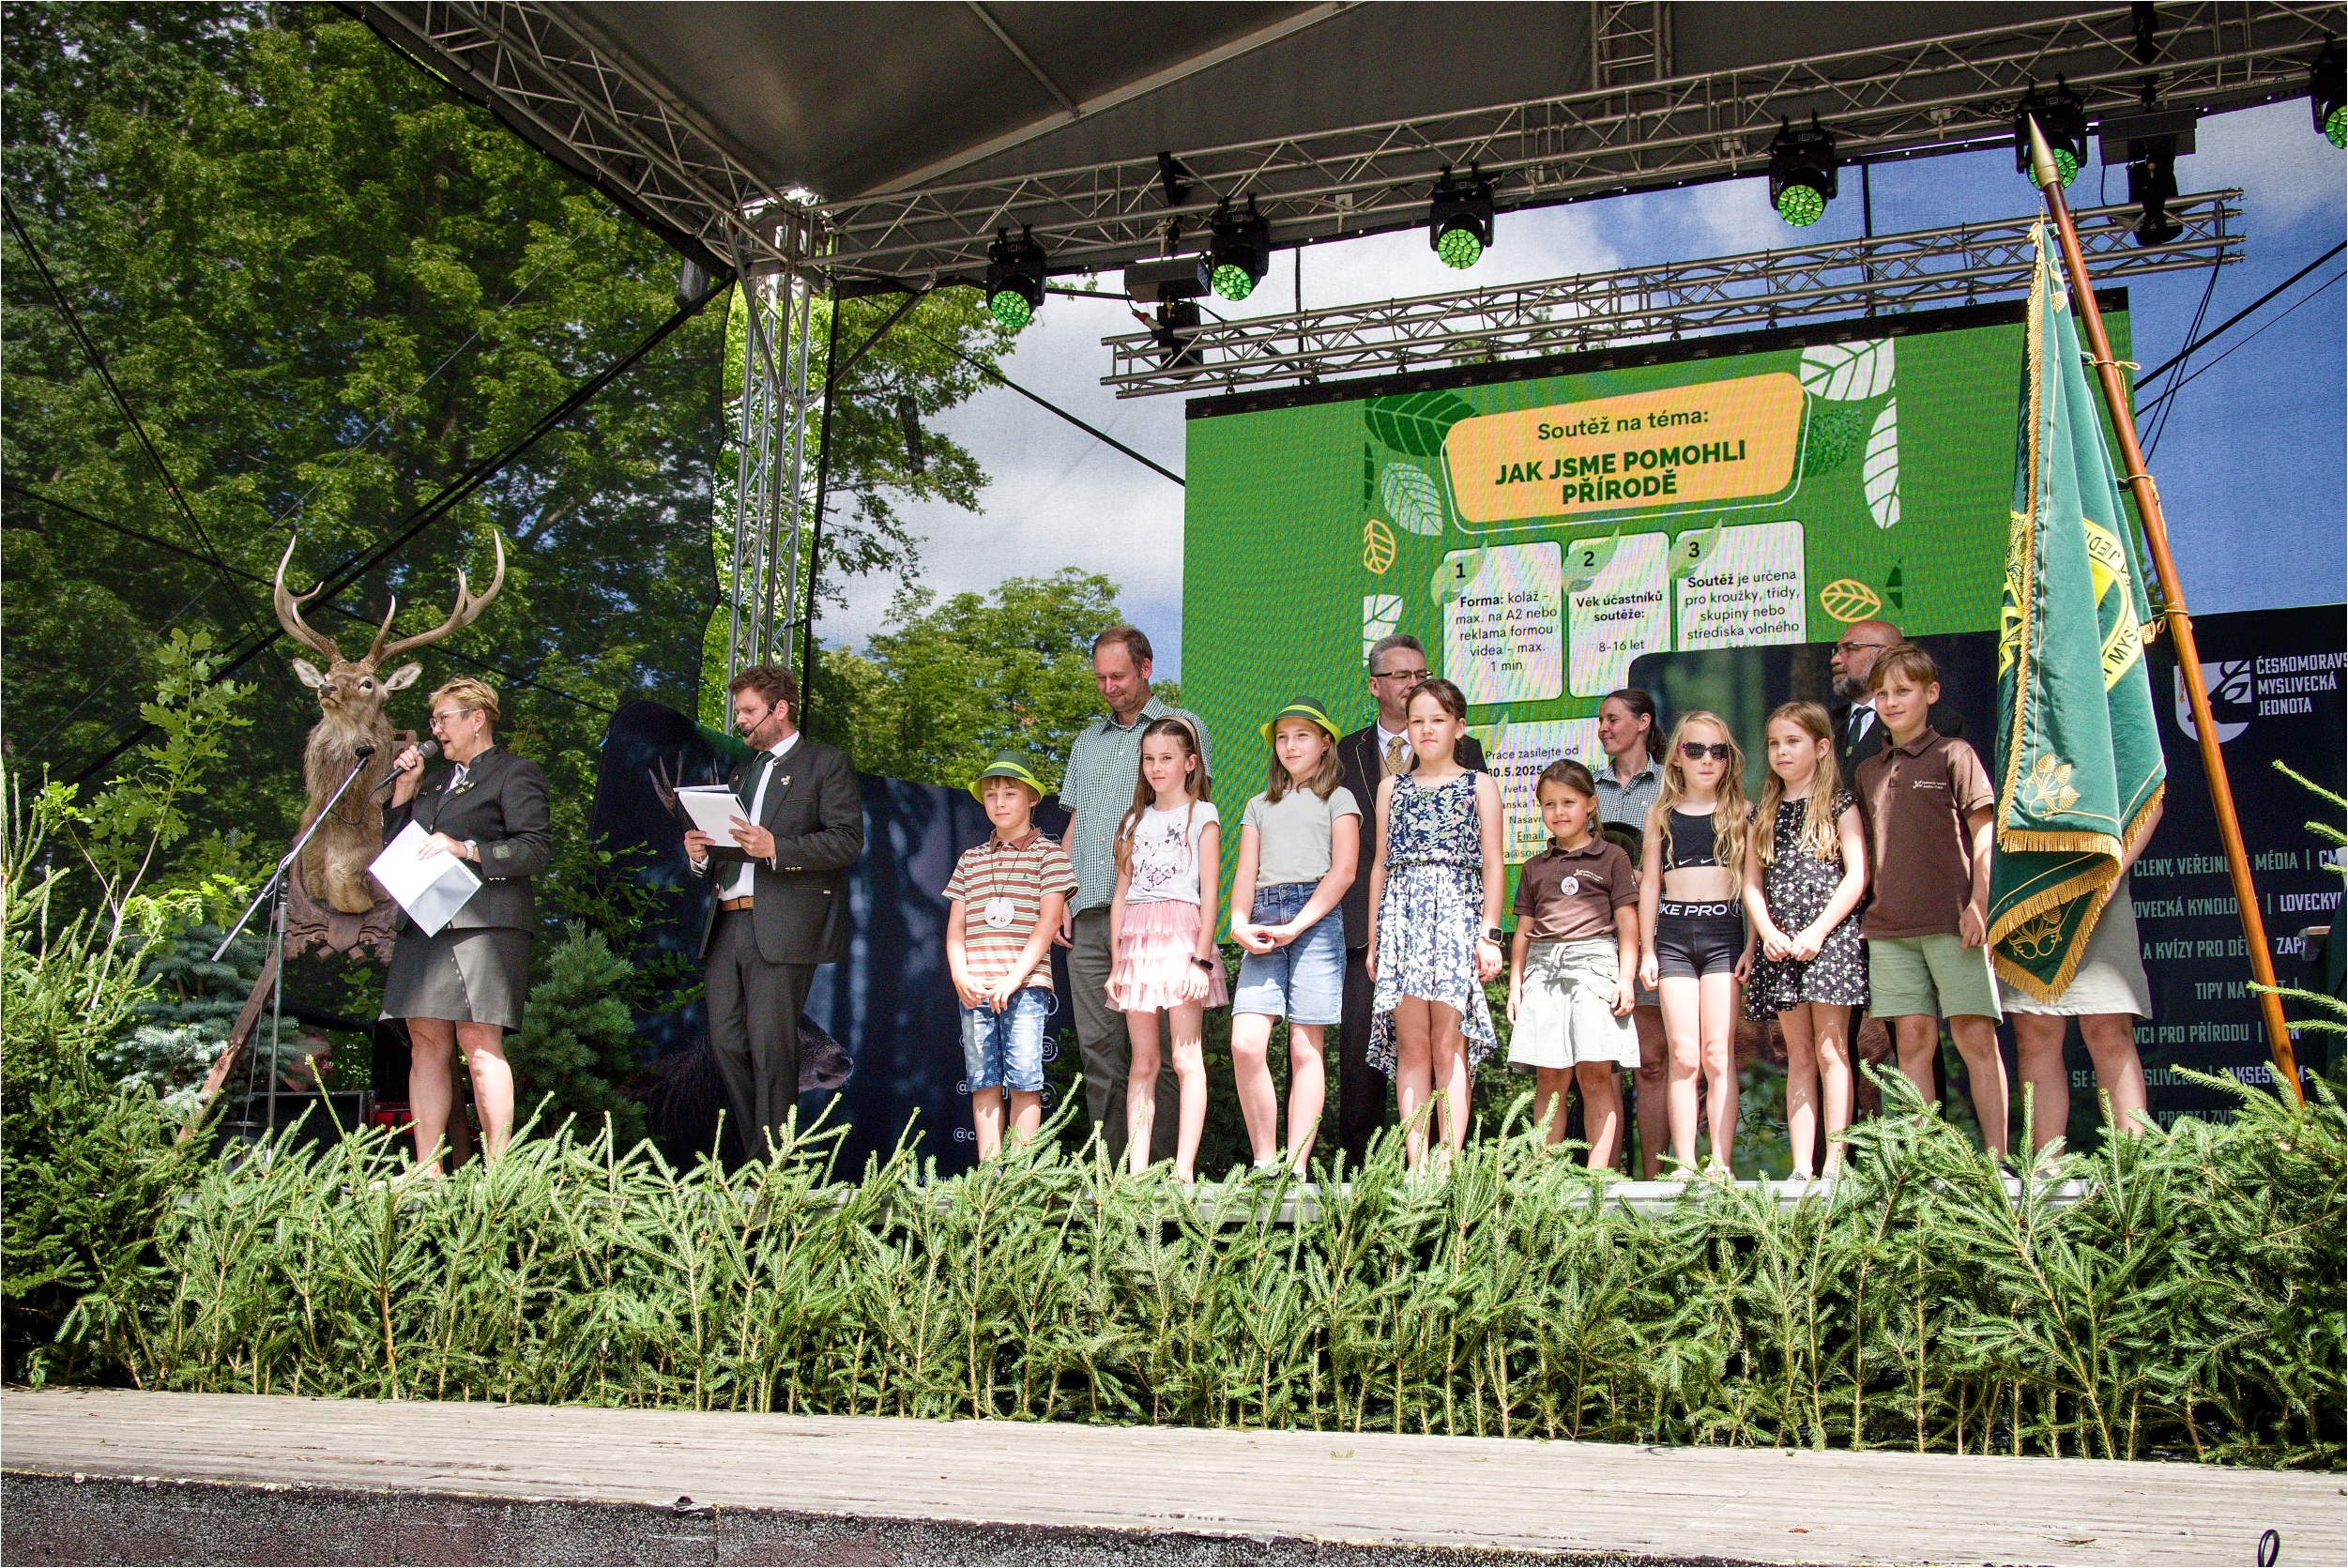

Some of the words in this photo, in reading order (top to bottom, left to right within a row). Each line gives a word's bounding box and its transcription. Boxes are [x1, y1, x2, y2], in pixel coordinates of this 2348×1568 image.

[1537, 416, 1610, 441] Soutěž
[1616, 415, 1641, 433] na
[1647, 409, 1710, 429] téma:
[1495, 461, 1543, 485] JAK
[1548, 452, 1617, 480] JSME
[1623, 439, 1746, 472] POMOHLI
[1562, 468, 1678, 505] PŘÍRODĚ
[1688, 541, 1700, 558] 3
[1583, 551, 1594, 567] 2
[1456, 563, 1466, 579] 1
[1687, 573, 1734, 588] Soutěž
[1737, 573, 1749, 587] je
[1753, 570, 1797, 583] určena
[1460, 596, 1503, 608] Forma:
[1507, 590, 1539, 604] koláž
[1577, 596, 1600, 608] Věk
[1603, 590, 1663, 606] účastníků
[1685, 596, 1706, 608] pro
[1710, 589, 1762, 603] kroužky,
[1766, 586, 1800, 600] třídy,
[1456, 614, 1485, 625] max.
[1487, 613, 1502, 622] na
[1506, 609, 1522, 620] A2
[1526, 606, 1558, 618] nebo
[1593, 608, 1645, 622] soutěže:
[1700, 608, 1749, 623] skupiny
[1753, 604, 1786, 617] nebo
[1459, 628, 1506, 641] reklama
[1510, 625, 1553, 637] formou
[1687, 624, 1745, 640] střediska
[1748, 620, 1800, 635] volného
[1470, 645, 1502, 657] videa
[1517, 643, 1546, 653] max.
[1629, 640, 1645, 650] let
[1490, 661, 1496, 672] 1
[1501, 660, 1523, 671] min
[2257, 670, 2338, 695] MYSLIVECKÁ
[2258, 696, 2313, 717] JEDNOTA
[1485, 750, 1516, 760] Práce
[1518, 747, 1562, 759] zasílejte
[1564, 744, 1579, 755] od
[1504, 784, 1528, 794] Iveta
[1517, 830, 1548, 842] Email:
[2254, 849, 2299, 871] MÉDIA
[1684, 904, 1728, 917] PRO
[2133, 896, 2185, 919] OVECKÁ
[2142, 942, 2152, 960] A
[2156, 938, 2194, 960] KVÍZY
[2197, 939, 2224, 958] PRO
[2195, 982, 2224, 1000] TIPY
[2227, 981, 2247, 999] NA
[2158, 1026, 2186, 1043] PRO
[2189, 1021, 2249, 1043] PŘÍRODU
